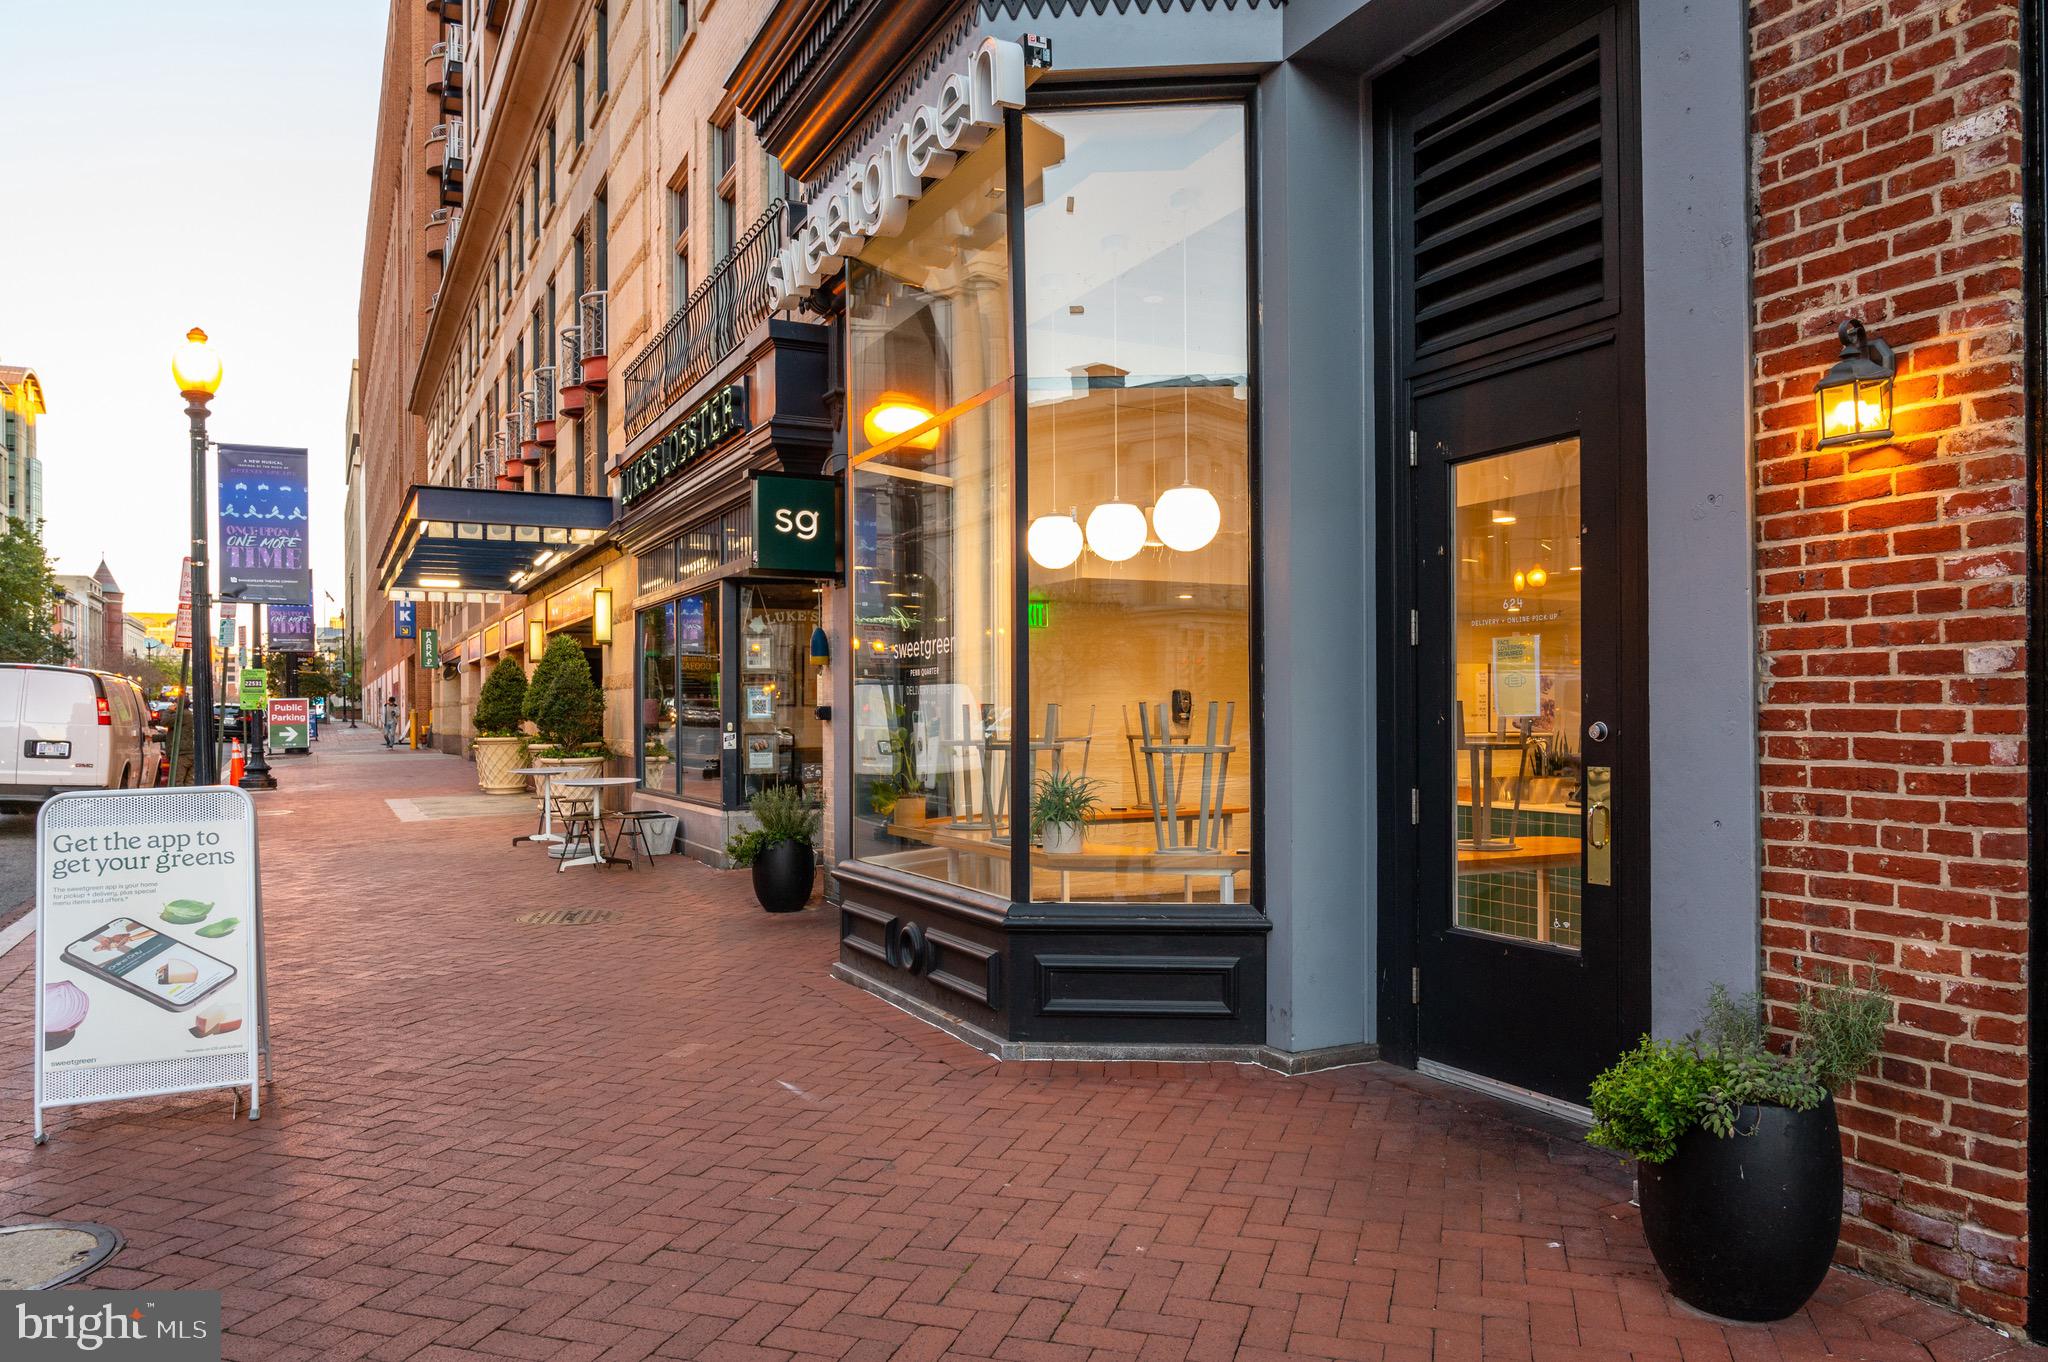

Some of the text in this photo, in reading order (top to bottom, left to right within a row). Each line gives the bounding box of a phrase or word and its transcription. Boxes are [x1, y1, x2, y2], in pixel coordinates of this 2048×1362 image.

[767, 35, 1026, 311] sweetgreen
[662, 386, 734, 475] LOBSTER
[226, 525, 300, 537] ONCE UPON A
[775, 508, 820, 541] sg
[226, 534, 302, 548] ONE MORE
[226, 546, 302, 569] TIME
[1503, 598, 1523, 610] 624
[765, 610, 819, 625] LUKE'S
[1028, 603, 1044, 625] XIT
[1471, 619, 1499, 627] DELIVERY
[1507, 616, 1530, 624] ONLINE
[1532, 614, 1547, 622] PICK
[271, 622, 312, 633] TIME
[425, 631, 433, 657] PARK
[921, 666, 939, 677] QUARTER
[271, 714, 306, 722] Parking
[53, 830, 220, 853] Get the app to
[52, 850, 235, 880] get your greens
[63, 892, 86, 900] pickup
[119, 889, 133, 897] plus
[66, 884, 104, 893] sweetgreen
[124, 882, 139, 890] your
[50, 1057, 97, 1068] sweetgreen
